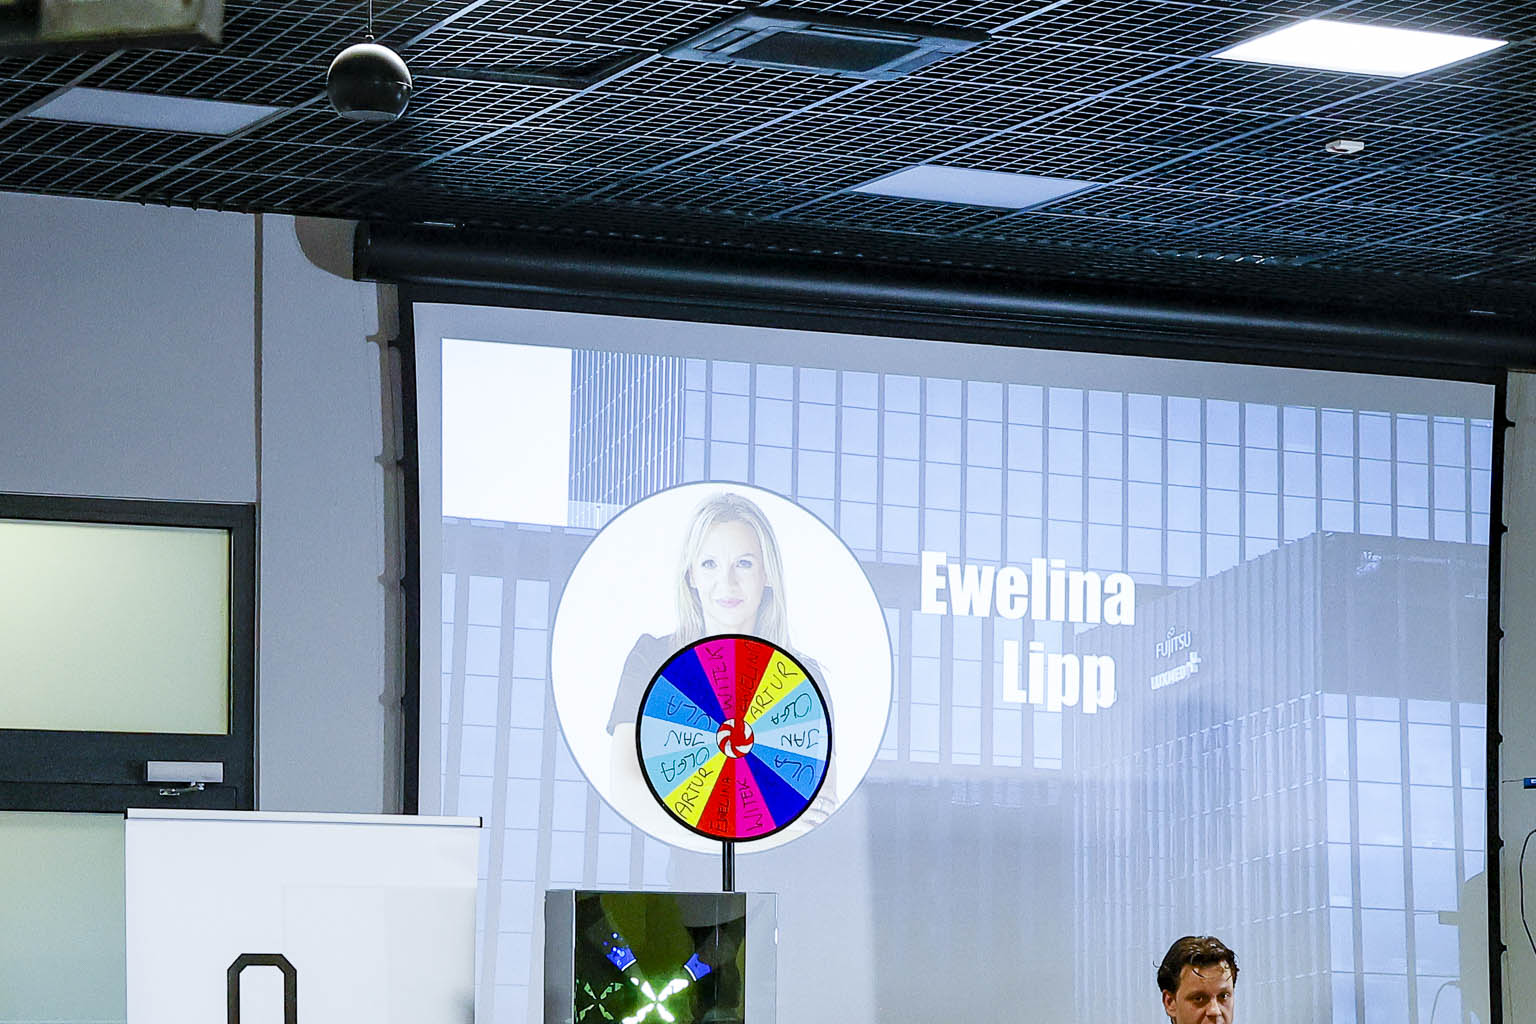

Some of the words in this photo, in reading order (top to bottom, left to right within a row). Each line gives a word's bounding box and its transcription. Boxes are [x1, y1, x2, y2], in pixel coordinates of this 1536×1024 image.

[921, 550, 1136, 626] Ewelina
[1156, 631, 1192, 658] FUJITSU
[705, 646, 729, 711] WITEK
[749, 661, 799, 720] ARTUR
[1002, 639, 1117, 714] Lipp
[666, 695, 713, 730] ULA
[770, 692, 813, 725] OLGA
[664, 730, 705, 747] JAN
[780, 728, 820, 749] JAN
[660, 746, 710, 782] OLGA
[774, 755, 816, 785] ULA
[674, 767, 714, 820] ARTUR
[738, 777, 764, 832] WITEK
